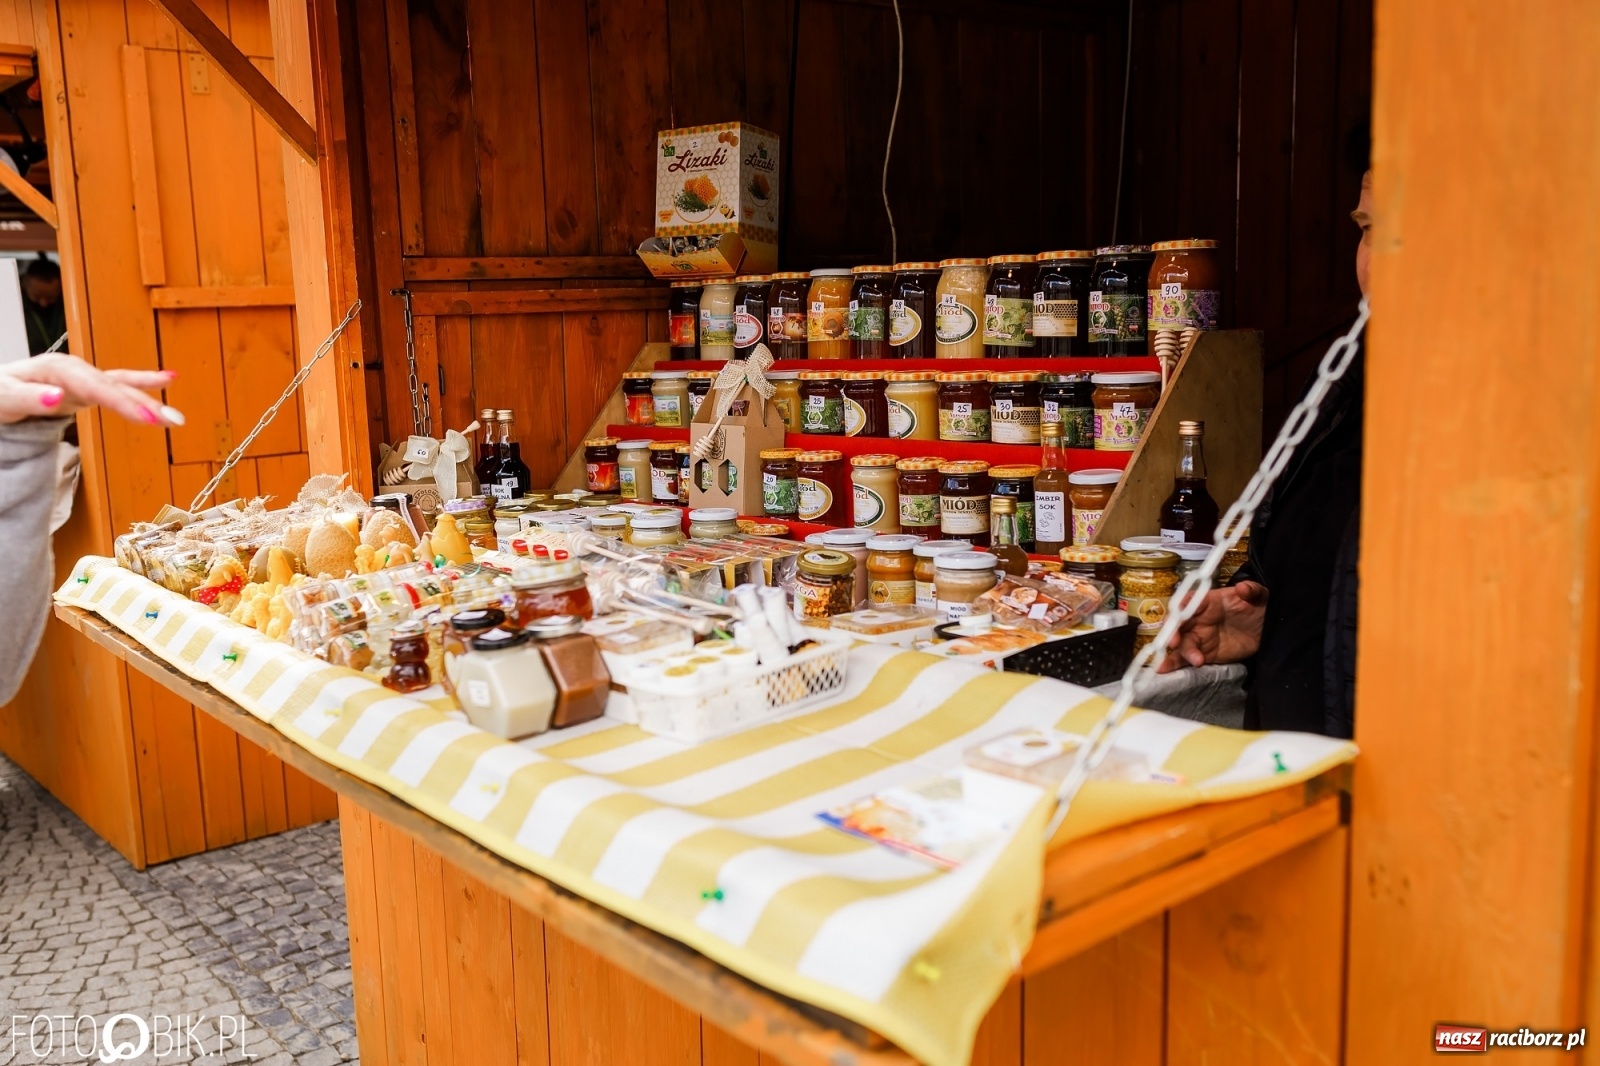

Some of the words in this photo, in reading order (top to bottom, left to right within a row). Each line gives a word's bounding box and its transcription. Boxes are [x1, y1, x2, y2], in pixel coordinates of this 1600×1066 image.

[668, 147, 728, 173] Lizaki
[744, 152, 776, 172] Lizaki
[1165, 285, 1179, 295] 90
[894, 301, 902, 310] 48
[957, 404, 970, 413] 25
[1000, 402, 1011, 411] 30
[1047, 403, 1056, 412] 32
[1120, 405, 1133, 415] 47
[942, 496, 977, 511] MIÓD
